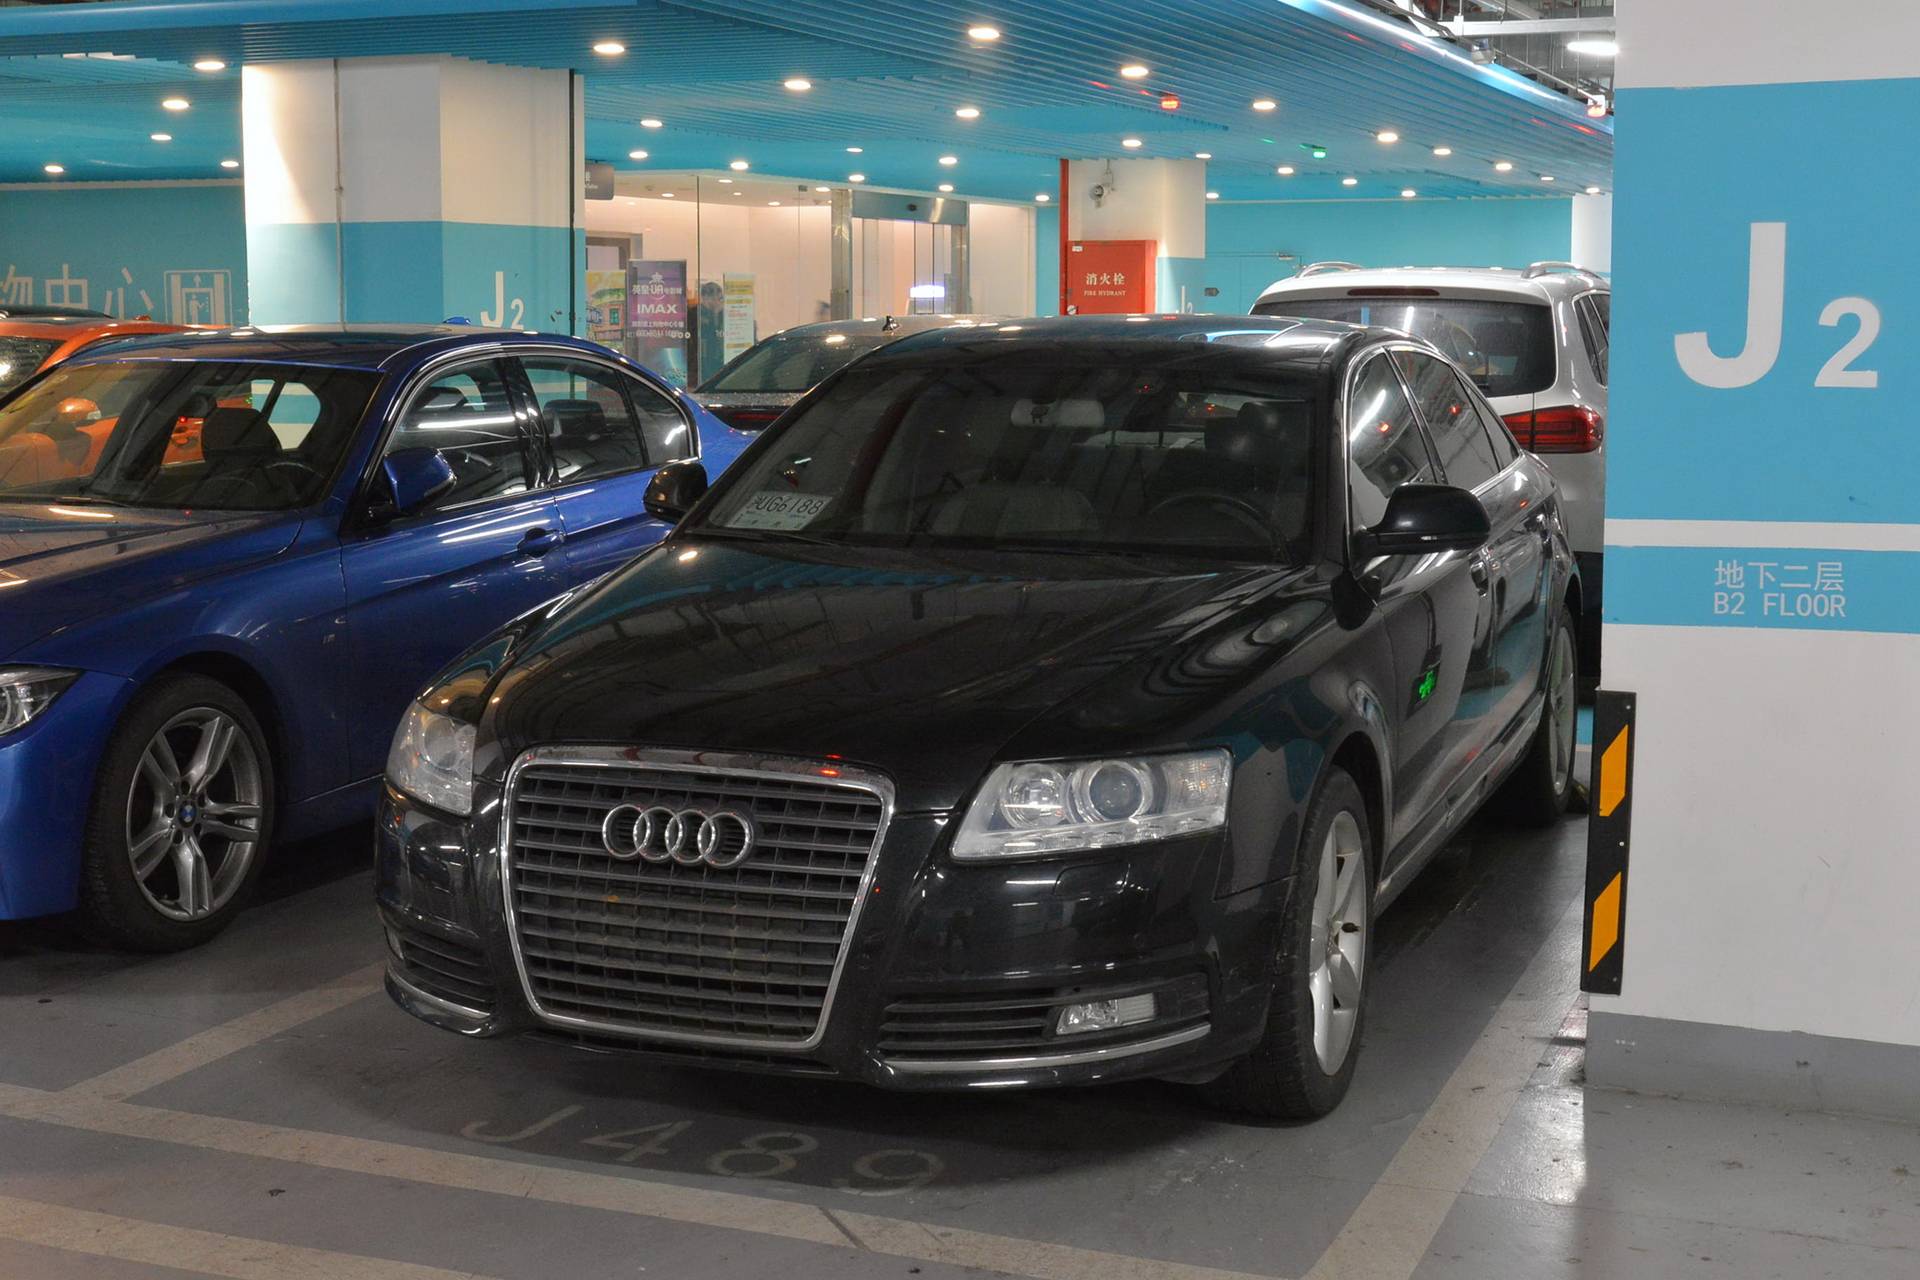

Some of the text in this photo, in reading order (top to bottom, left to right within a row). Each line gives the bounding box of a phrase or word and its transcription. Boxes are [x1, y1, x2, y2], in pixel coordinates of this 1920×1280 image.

[1086, 272, 1125, 286] 消火栓
[480, 271, 524, 330] J2
[637, 304, 678, 314] IMAX
[1674, 222, 1880, 388] J2
[1714, 559, 1844, 592] 地下二层
[1714, 591, 1846, 617] B2 FLOOR
